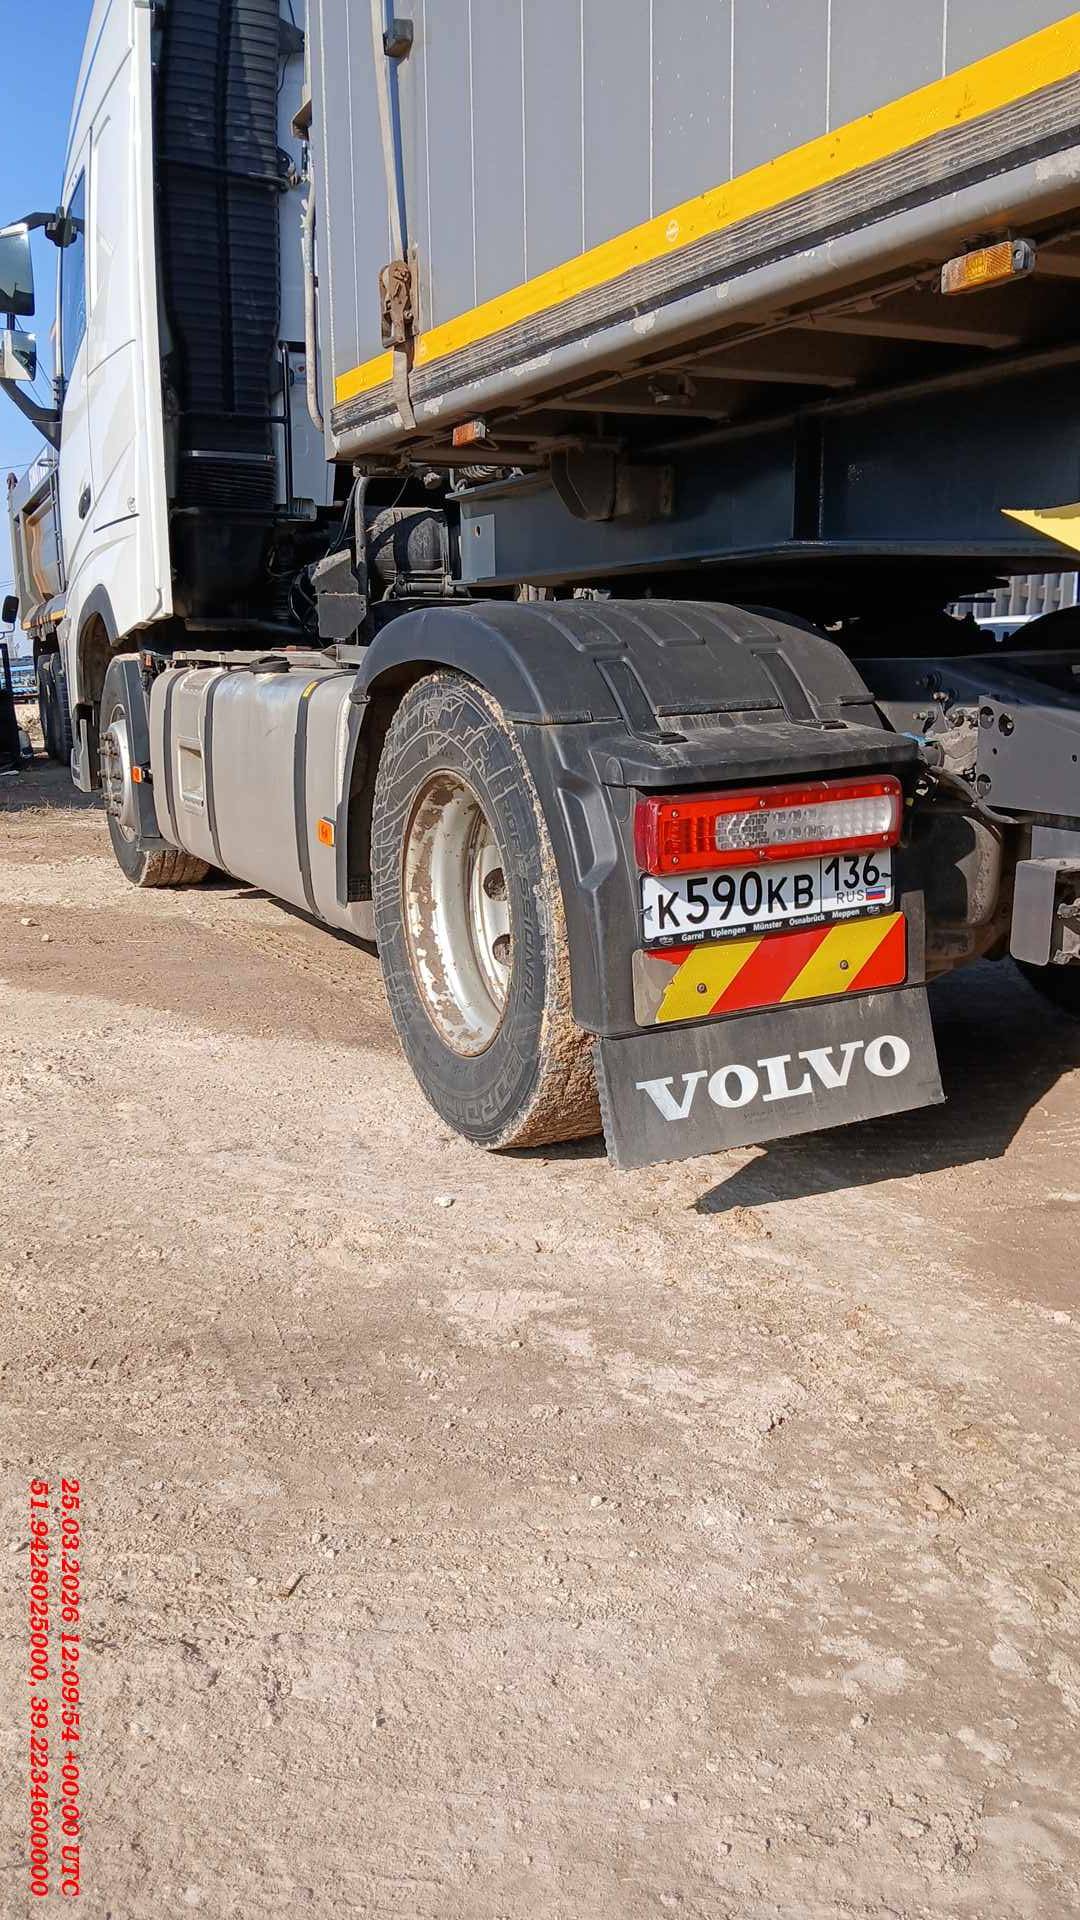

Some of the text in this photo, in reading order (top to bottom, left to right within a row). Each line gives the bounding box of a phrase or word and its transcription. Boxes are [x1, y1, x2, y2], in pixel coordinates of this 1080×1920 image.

[824, 855, 880, 892] 136
[836, 889, 864, 905] RUS
[681, 931, 704, 942] Garrel
[711, 926, 746, 938] Uplengen
[753, 918, 782, 932] Münster
[789, 913, 825, 926] Osnabrück
[832, 909, 860, 919] Meppen
[636, 1035, 910, 1121] VOLVO
